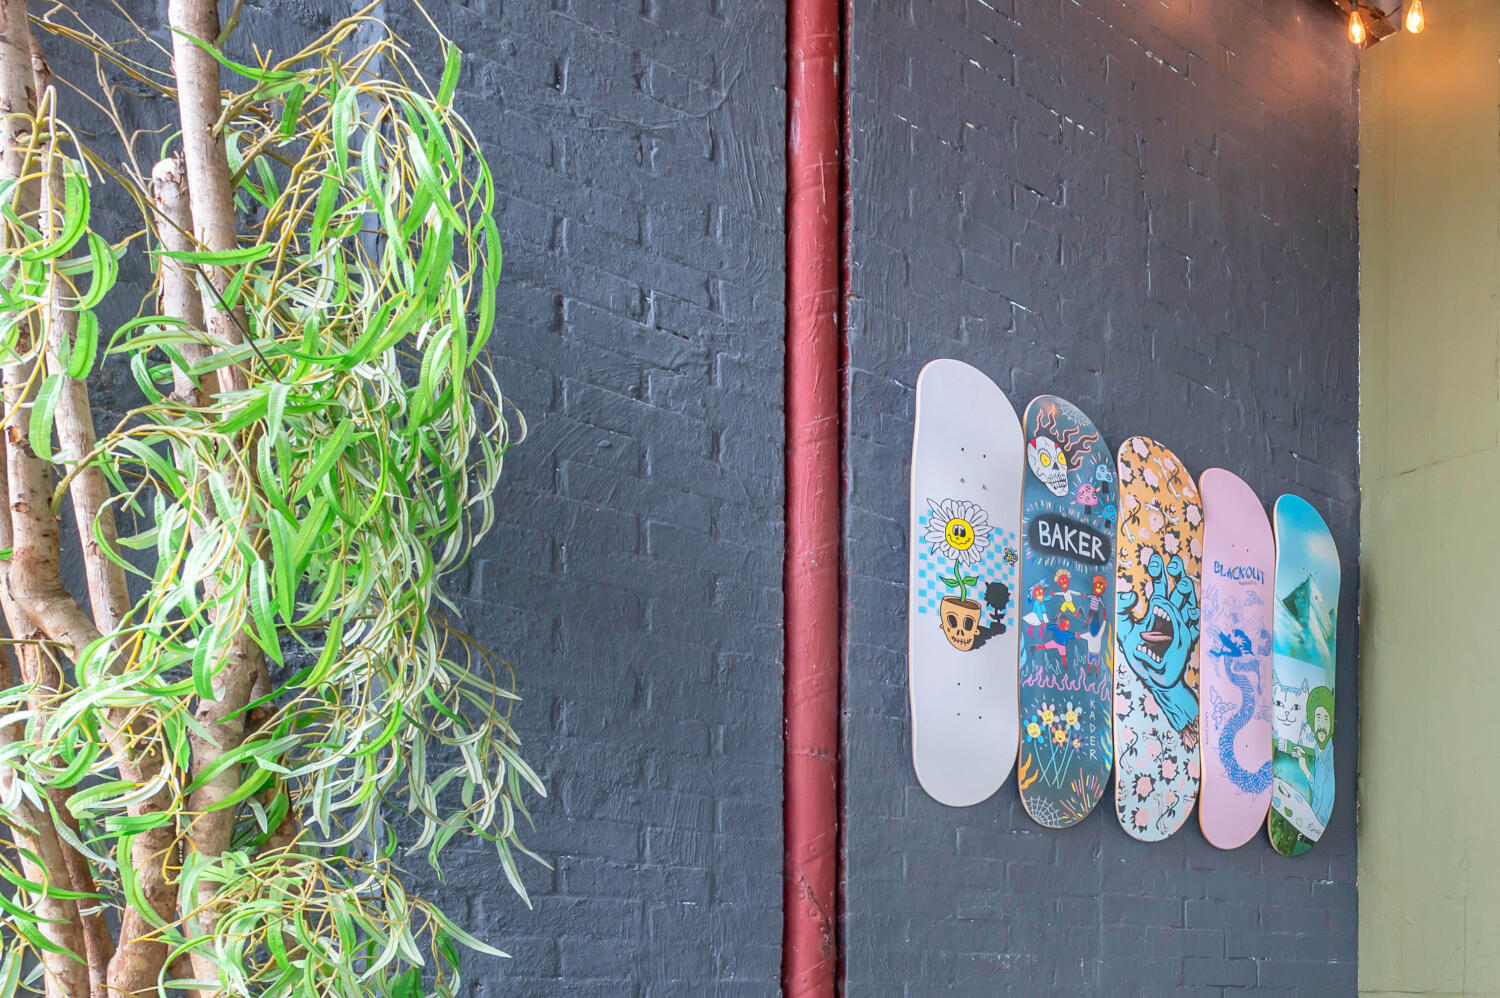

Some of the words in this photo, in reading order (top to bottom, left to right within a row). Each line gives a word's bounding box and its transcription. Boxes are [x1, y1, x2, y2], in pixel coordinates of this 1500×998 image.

[1038, 520, 1106, 562] BAKER
[1213, 560, 1265, 585] BLACKOUT
[1089, 699, 1098, 761] KADER
